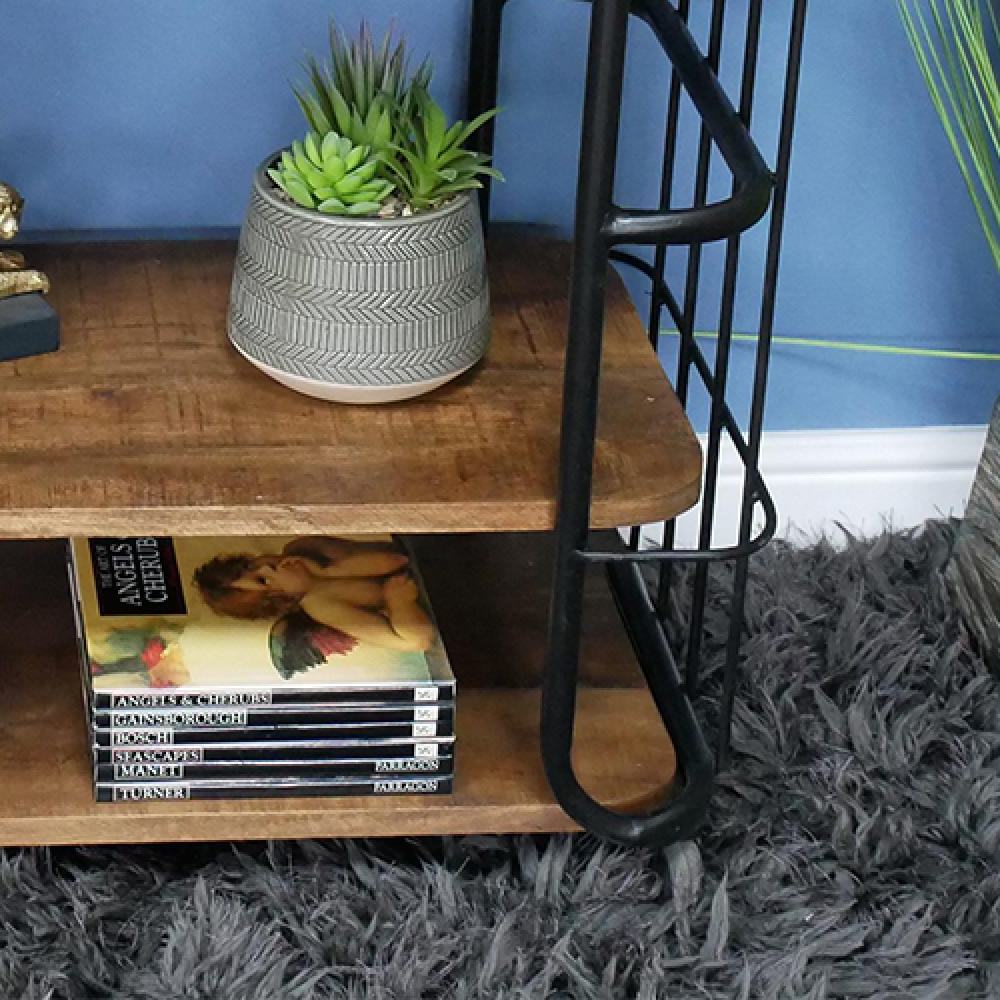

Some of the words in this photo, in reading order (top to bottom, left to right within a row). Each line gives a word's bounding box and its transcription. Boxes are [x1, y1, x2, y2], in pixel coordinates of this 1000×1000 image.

[109, 543, 143, 606] ANGELS
[117, 693, 177, 707] ANGELS
[197, 692, 271, 706] CHERUBS
[115, 711, 244, 726] GAINSBOROUGH
[116, 731, 168, 745] BOSCH
[115, 750, 200, 762] SEASCAPES
[119, 764, 179, 777] MANET
[119, 785, 187, 800] TURNER
